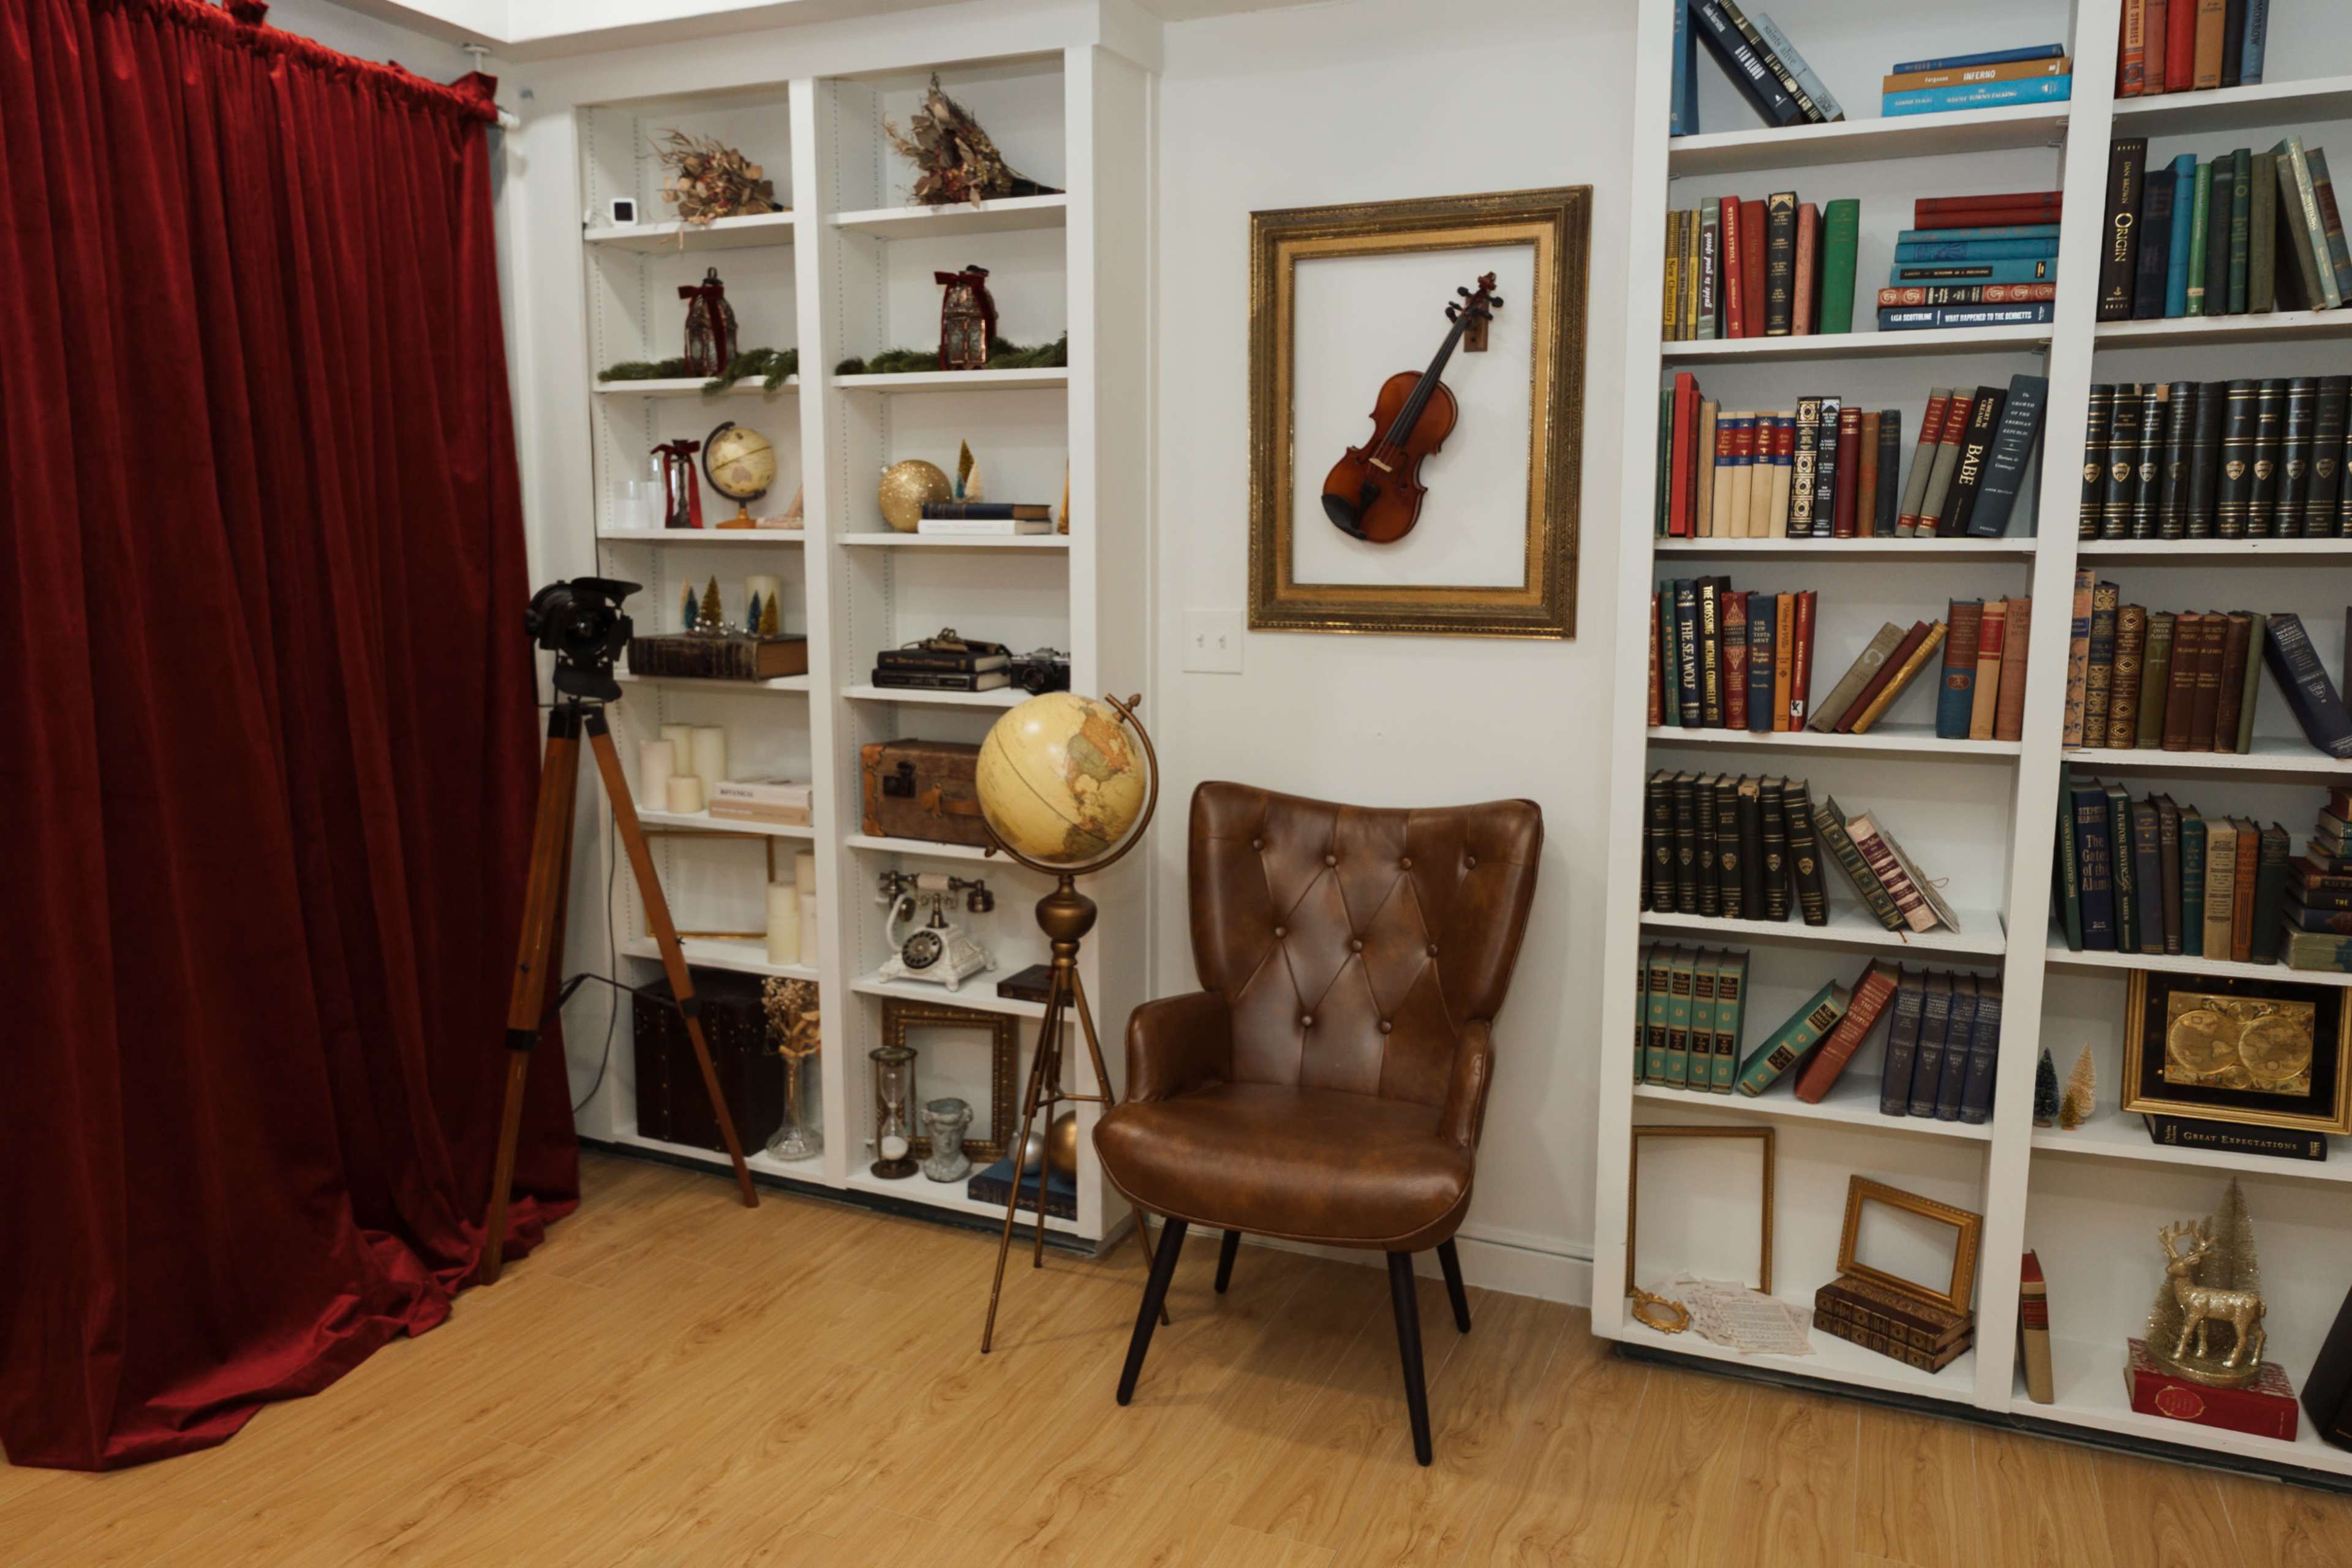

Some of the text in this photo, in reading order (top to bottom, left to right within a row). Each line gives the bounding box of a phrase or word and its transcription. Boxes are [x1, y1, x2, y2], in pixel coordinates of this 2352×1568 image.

[2130, 11, 2139, 44] STORIES
[1763, 25, 1796, 65] saints alive
[1964, 69, 1996, 81] INFERNO
[1704, 232, 1714, 254] speech
[2114, 213, 2133, 262] ORIGIN
[1703, 257, 1714, 276] good
[1665, 260, 1676, 322] New Chemistry
[1703, 287, 1713, 308] guide
[1890, 312, 1932, 322] LISA SCOTTOLINE
[1945, 314, 1959, 322] WHAT
[1960, 312, 1986, 322] HAPPENED
[1994, 312, 2004, 321] THE
[2005, 311, 2032, 320] BENNETTS
[1959, 443, 1983, 485] BABE
[1681, 620, 1694, 641] THE
[1703, 586, 1717, 704] THE CROSSING MICHAEL CONNELLY
[2117, 813, 2126, 844] PURPOSE
[2086, 834, 2104, 848] The
[2082, 862, 2094, 876] of
[2183, 1131, 2297, 1150] GREAT EXPECTATIONS
